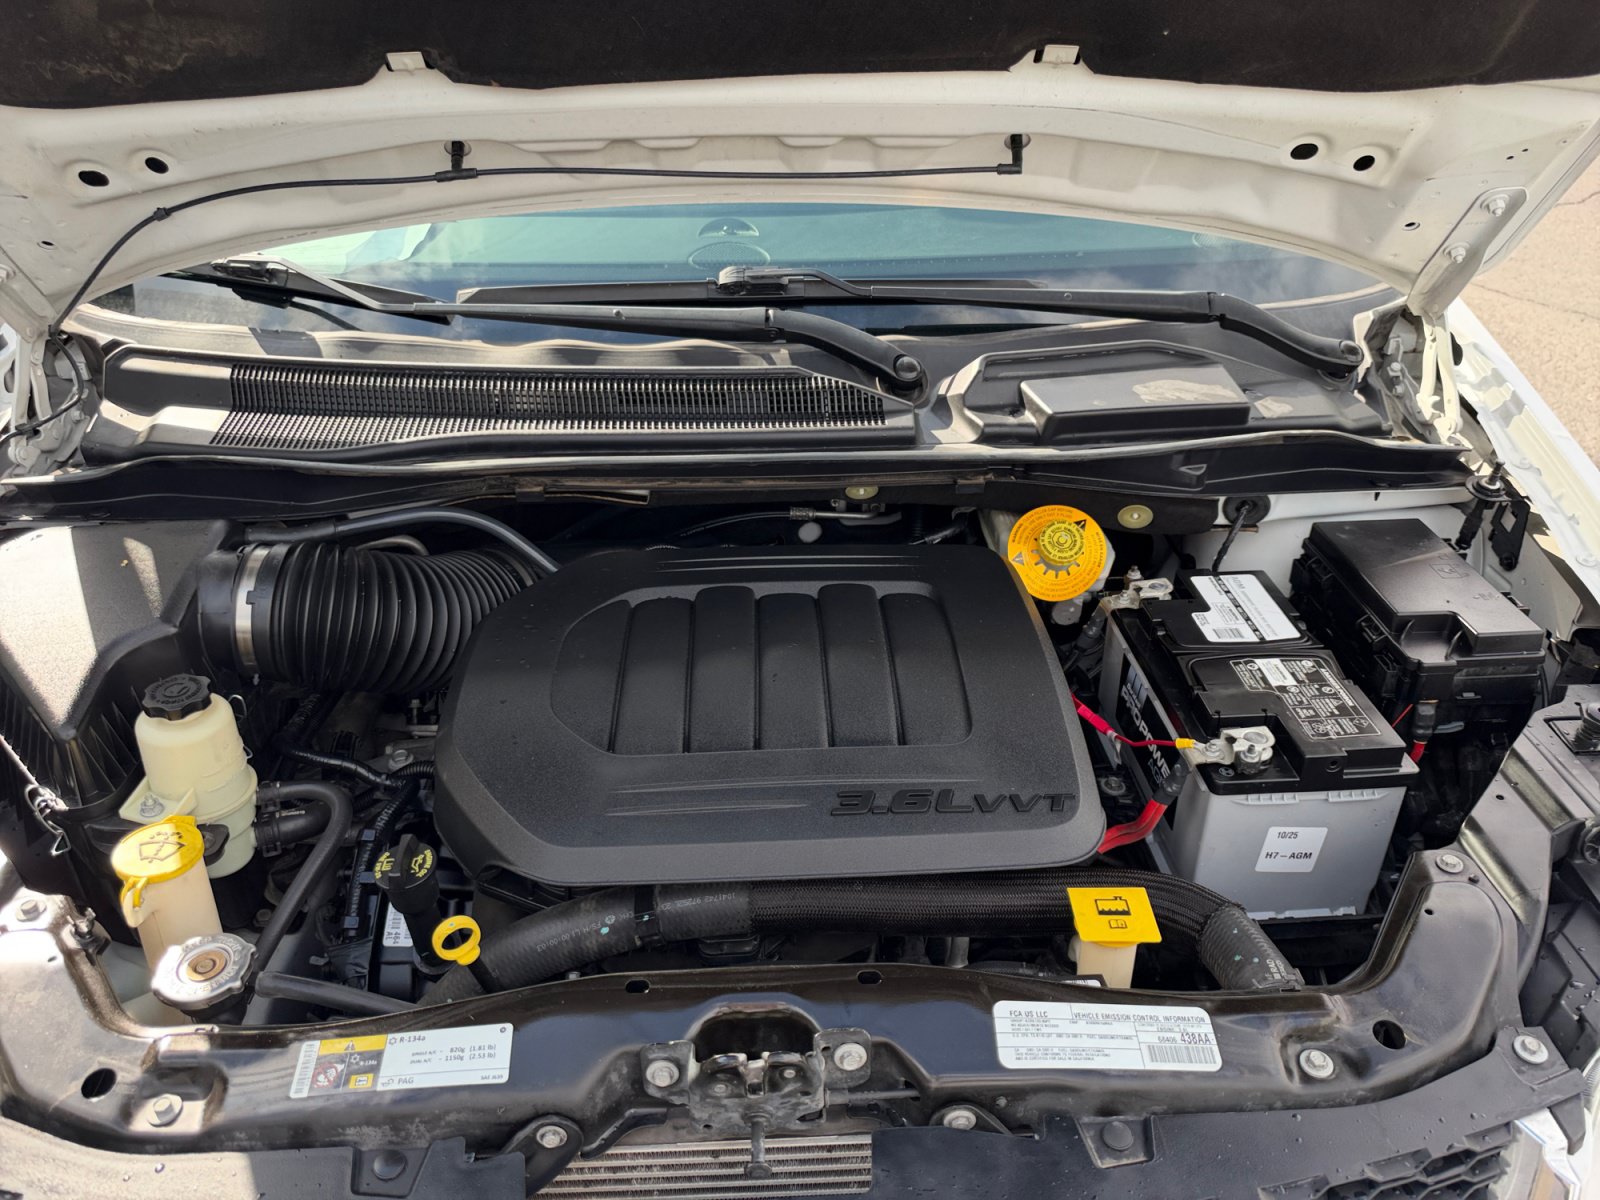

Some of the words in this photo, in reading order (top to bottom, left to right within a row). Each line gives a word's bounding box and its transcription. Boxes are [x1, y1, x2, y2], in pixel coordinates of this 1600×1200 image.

[1120, 684, 1171, 780] PROPOWE
[831, 788, 974, 816] 3.6L
[974, 793, 1076, 813] VVT
[1277, 831, 1299, 840] 10/25
[1009, 1010, 1022, 1018] FCA
[1024, 1010, 1034, 1018] US
[1036, 1010, 1048, 1018] LLC
[1074, 1011, 1099, 1020] VEHICLE
[1101, 1013, 1131, 1021] EMISSION
[1133, 1014, 1160, 1022] CONTROL
[1163, 1014, 1206, 1023] INFORMATION
[399, 1034, 426, 1044] R-134a
[1180, 1031, 1212, 1046] 438AA
[450, 1046, 466, 1055] 820g
[469, 1044, 485, 1053] (1.81
[486, 1044, 497, 1052] lb)
[445, 1054, 464, 1063] 1150g
[469, 1052, 485, 1061] (2.53
[486, 1051, 497, 1060] lb)
[398, 1077, 414, 1086] PAG
